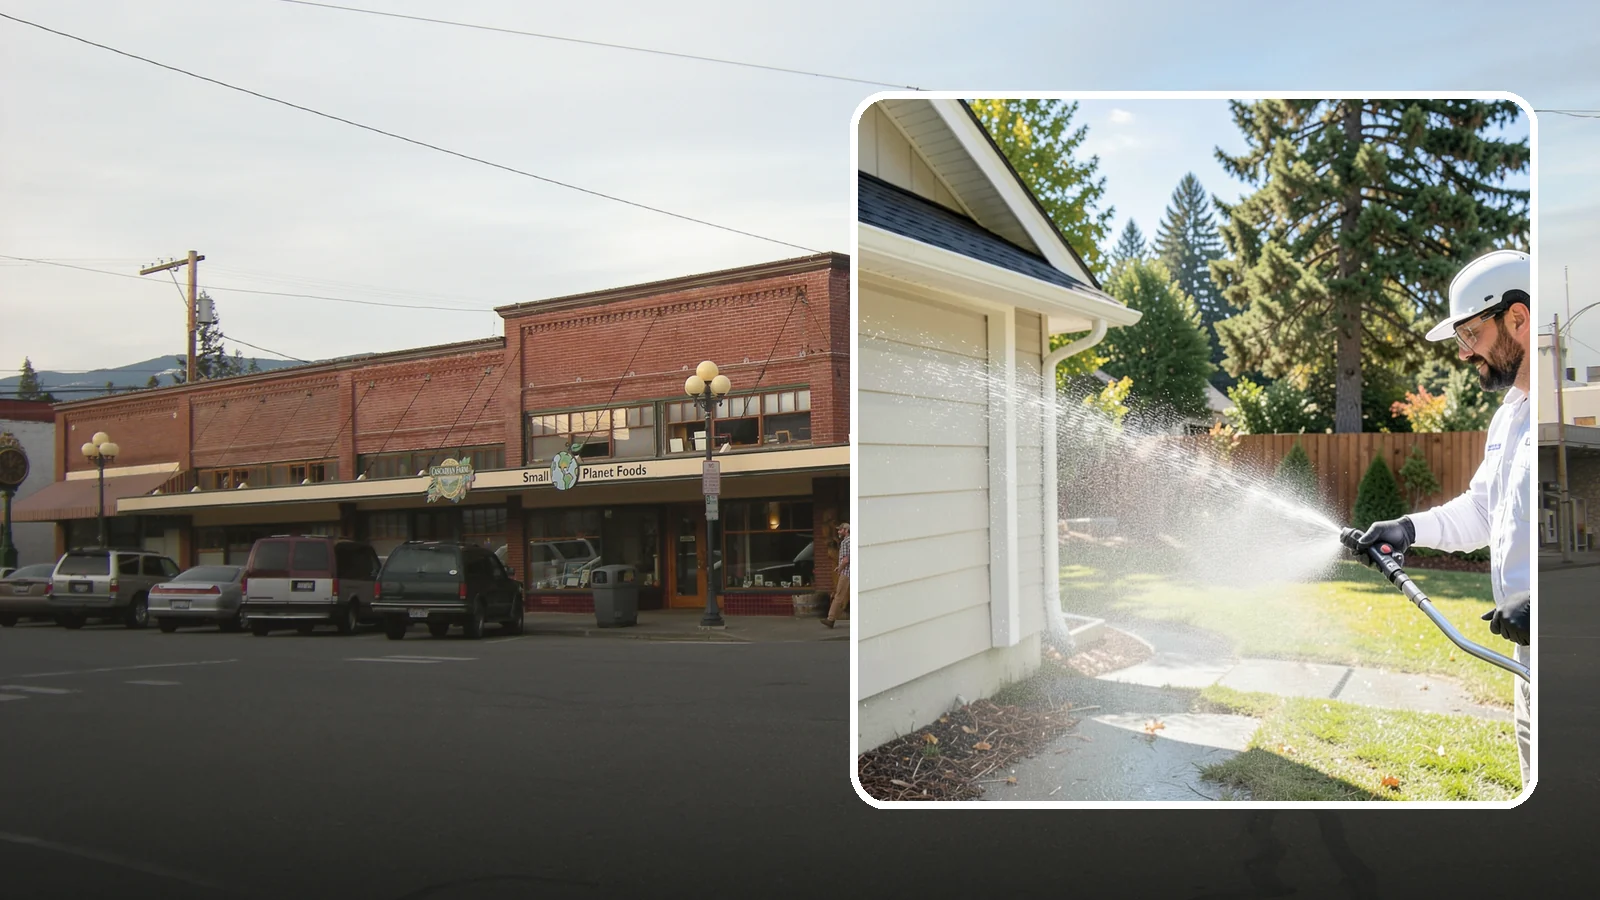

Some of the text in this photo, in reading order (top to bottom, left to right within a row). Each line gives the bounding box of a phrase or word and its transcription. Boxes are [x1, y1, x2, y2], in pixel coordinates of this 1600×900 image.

[456, 466, 469, 474] FARM
[523, 464, 647, 483] Small Planet Foods
